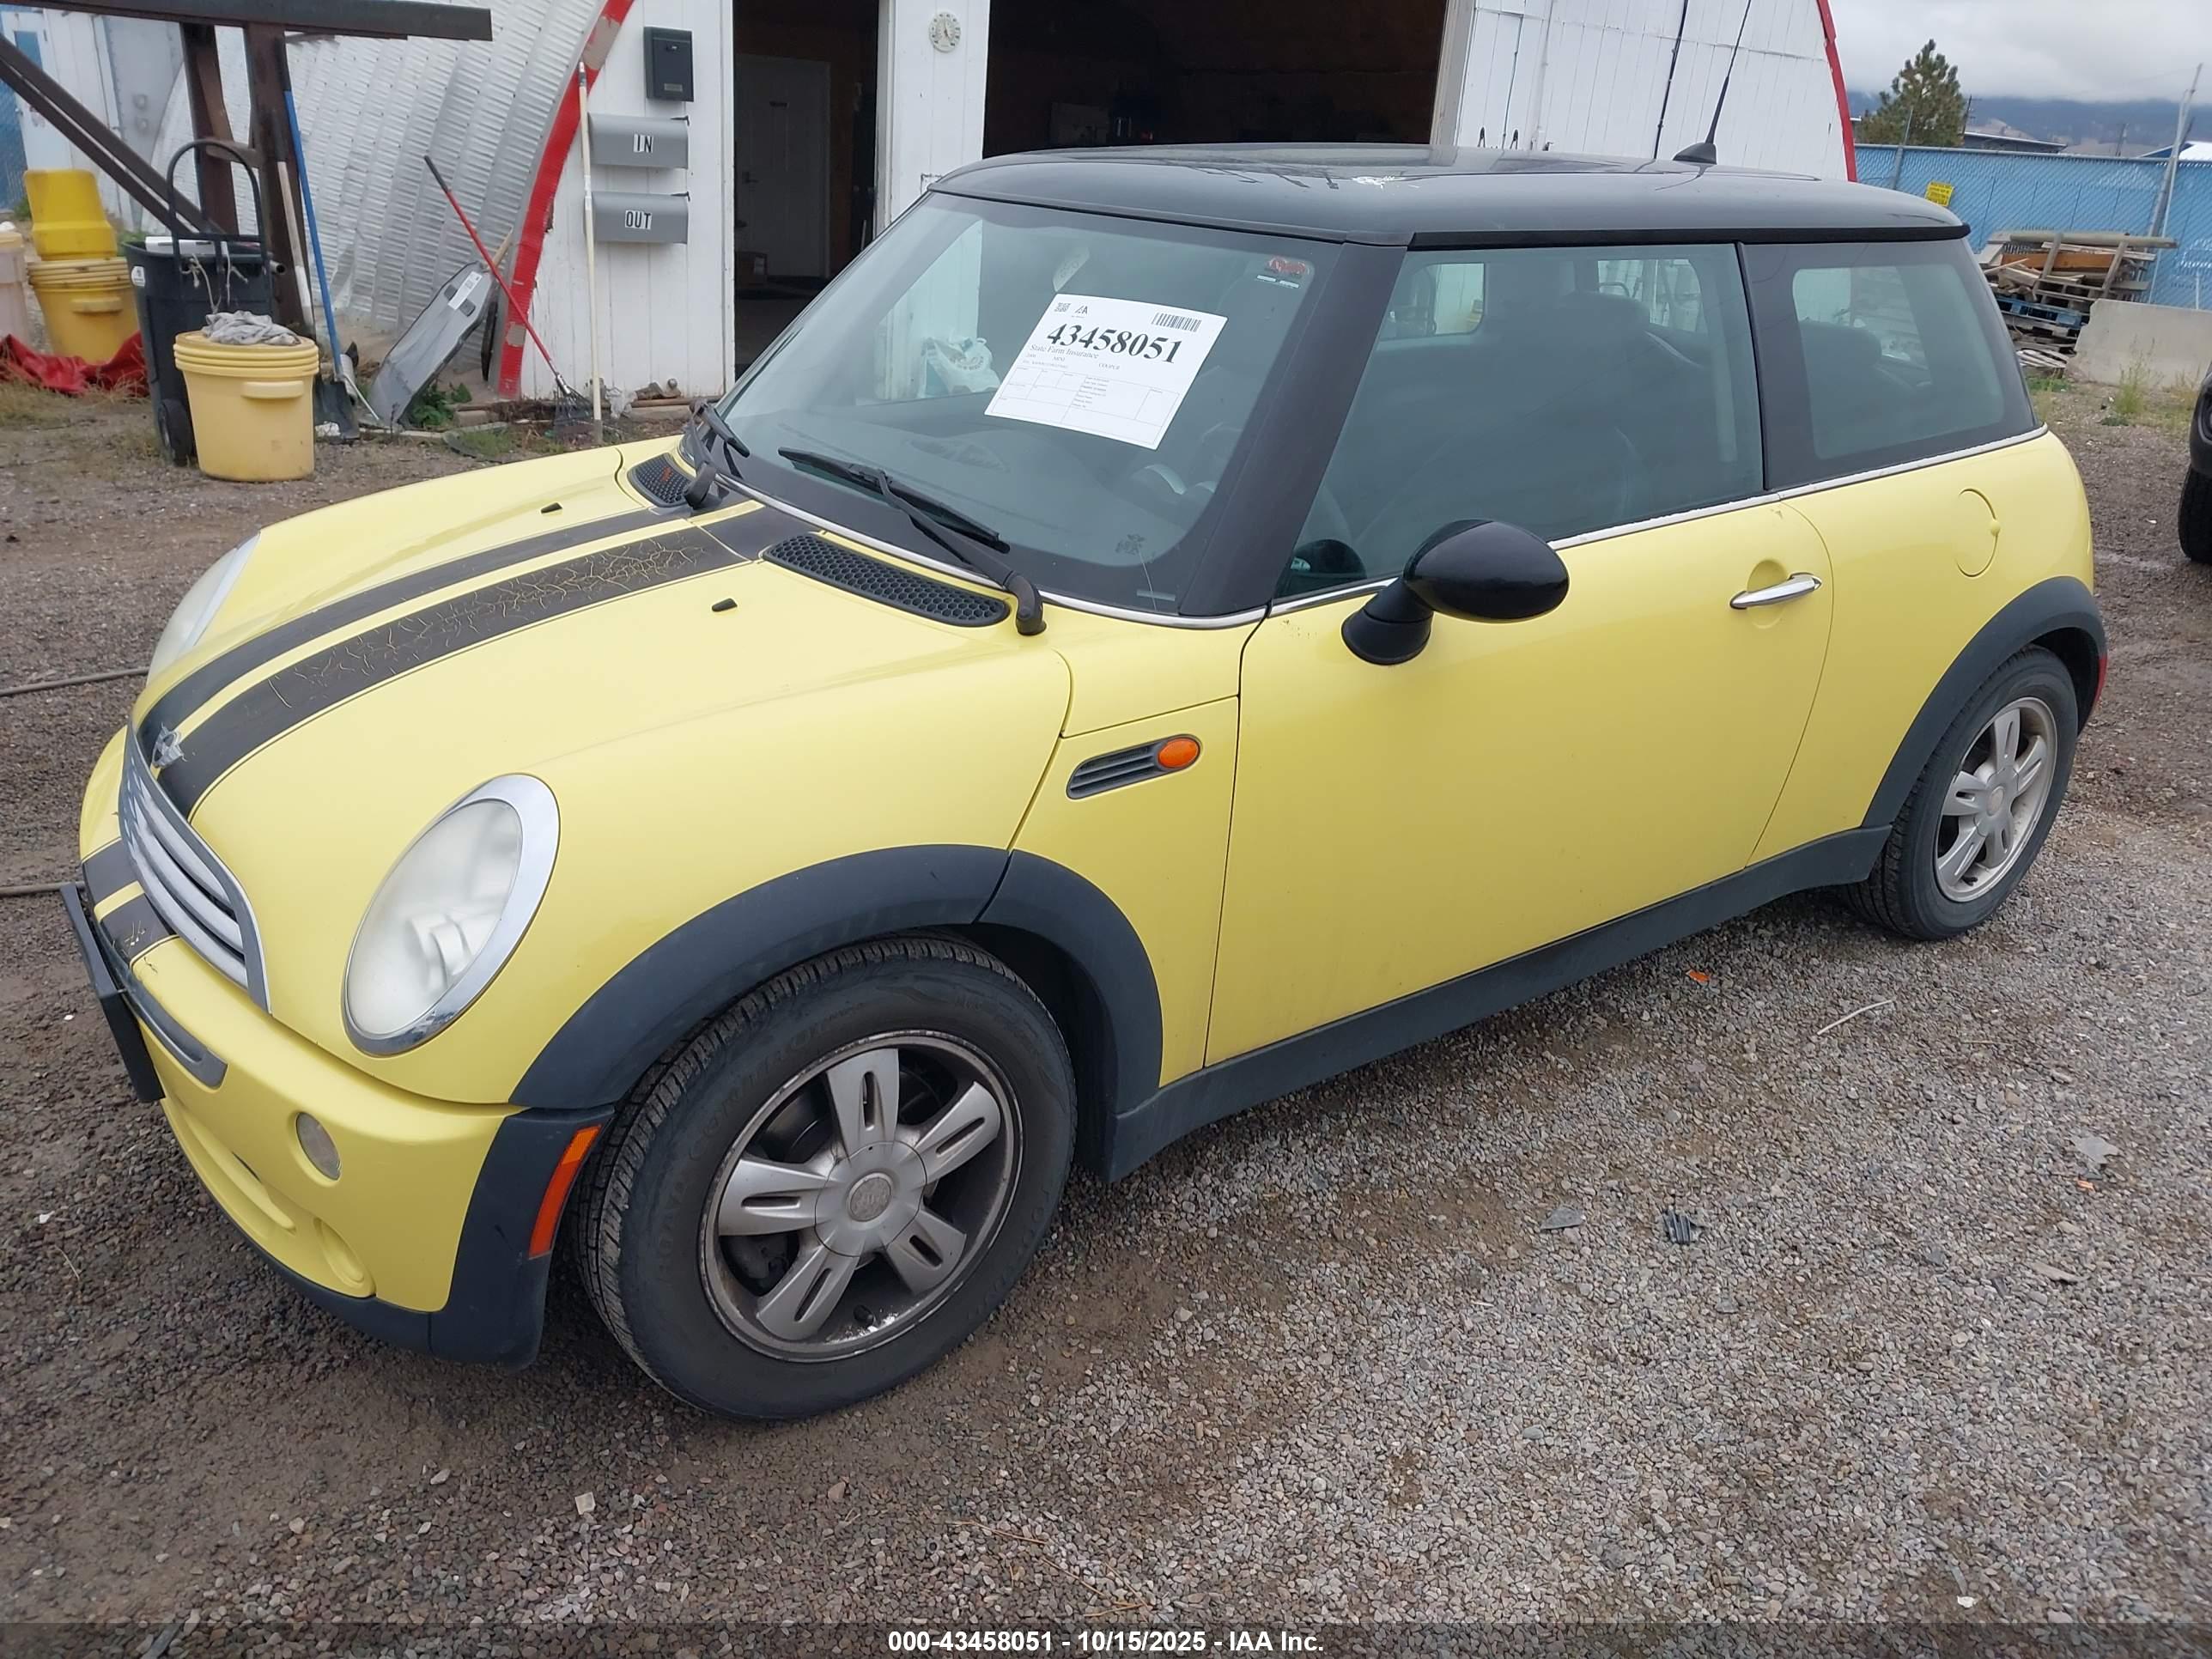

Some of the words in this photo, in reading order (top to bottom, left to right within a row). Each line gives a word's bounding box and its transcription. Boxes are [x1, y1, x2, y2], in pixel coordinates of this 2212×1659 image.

[637, 135, 653, 153] IN
[626, 211, 651, 228] OUT
[1047, 323, 1182, 363] 43458051
[1047, 345, 1065, 355] Farm
[1066, 348, 1099, 359] Insurance
